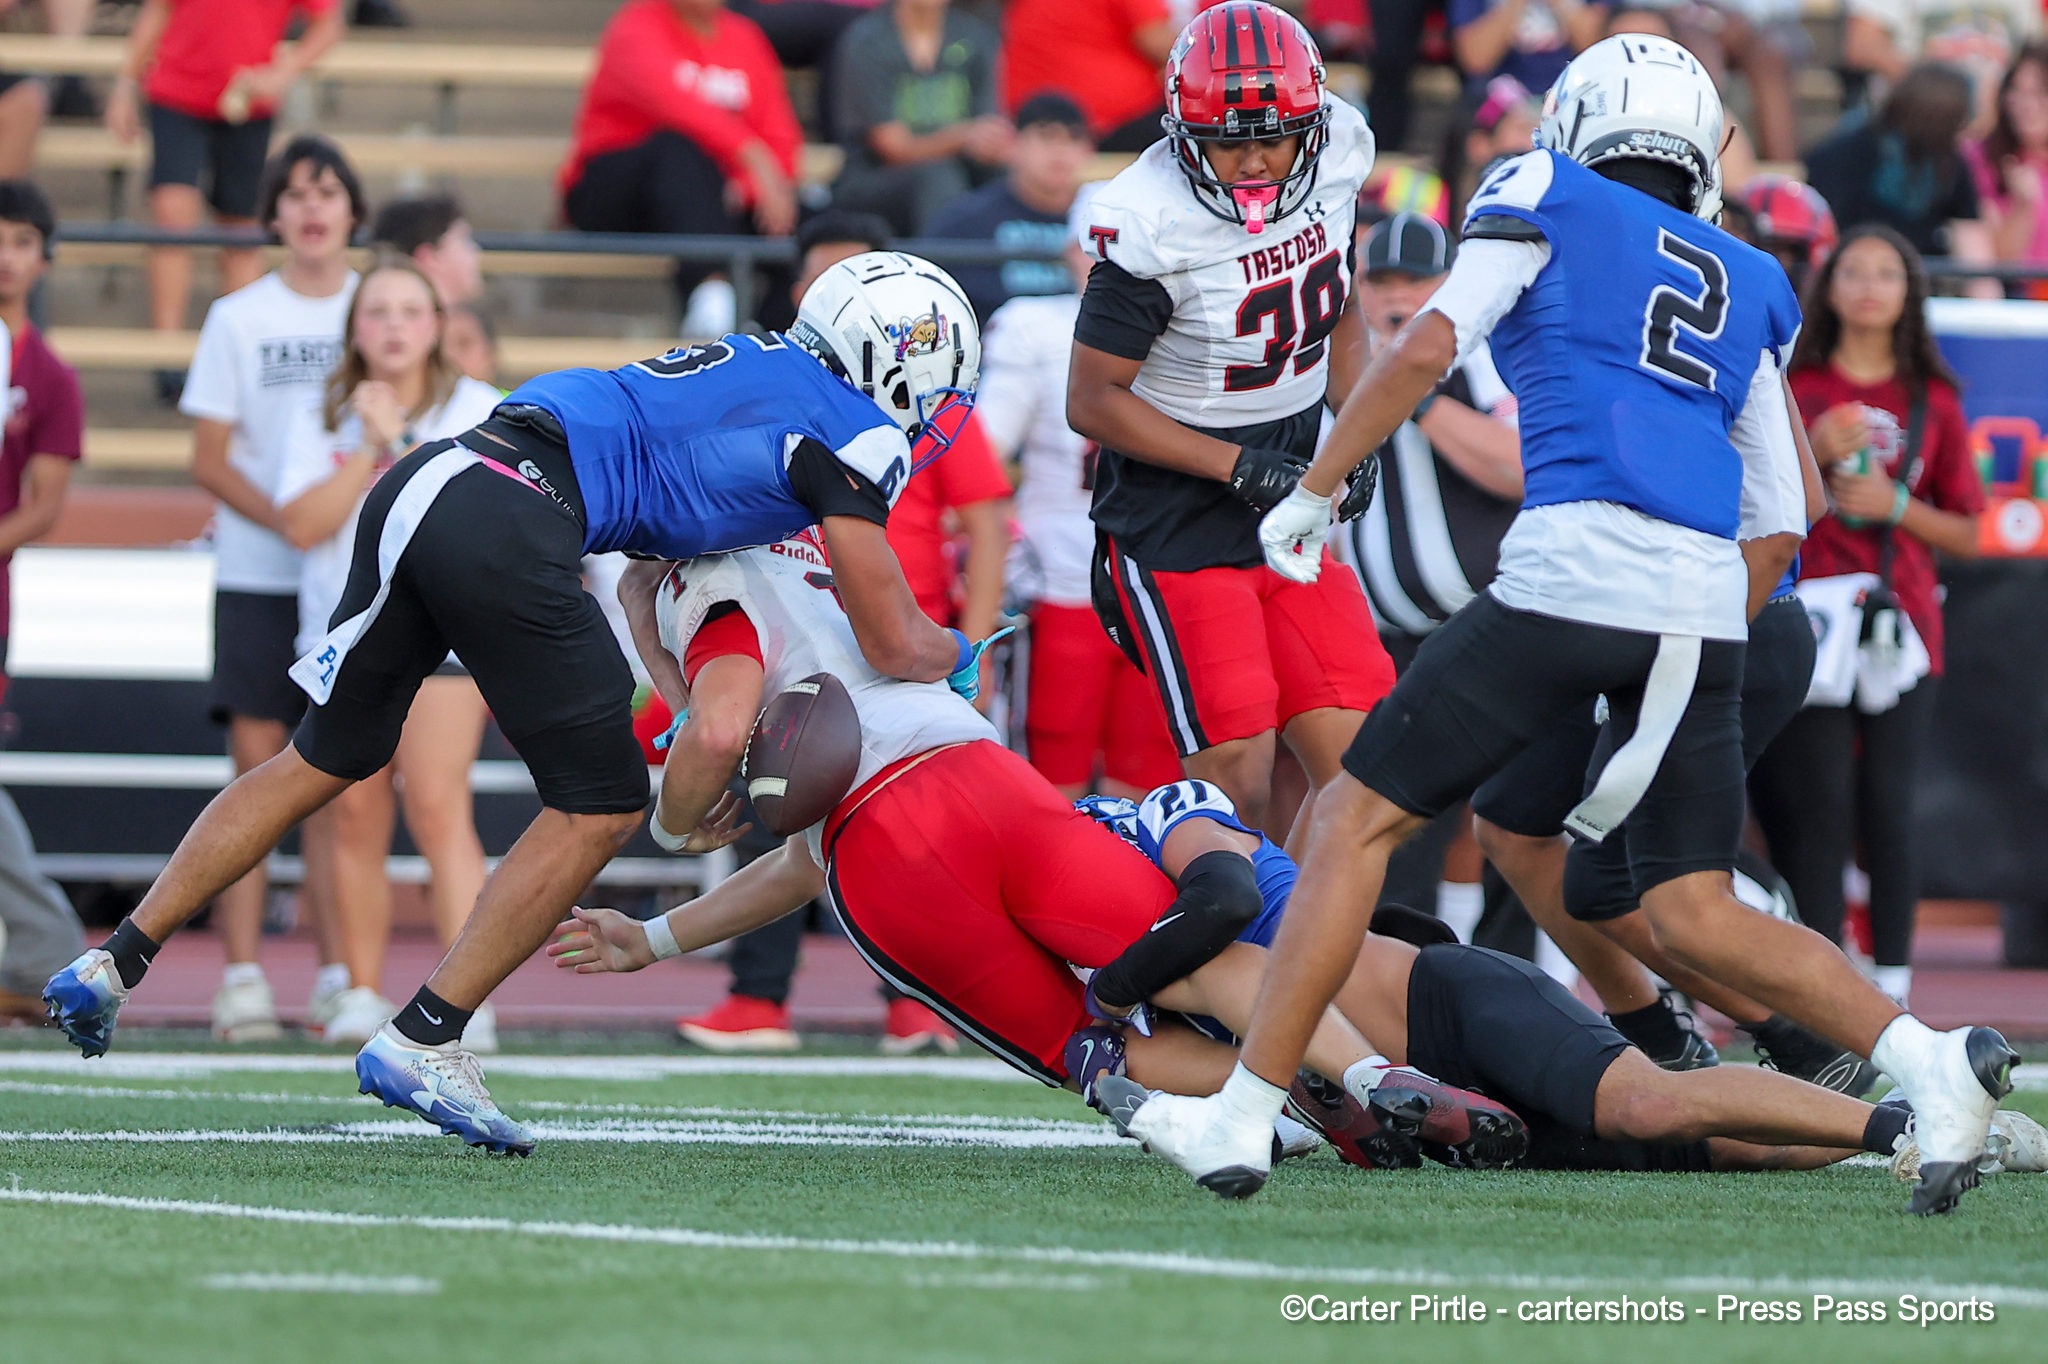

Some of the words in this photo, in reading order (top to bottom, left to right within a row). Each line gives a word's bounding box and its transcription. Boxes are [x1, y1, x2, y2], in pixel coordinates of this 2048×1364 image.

[1628, 130, 1690, 153] schutt
[1089, 225, 1119, 259] T
[1237, 221, 1328, 285] TASCOSA
[1639, 225, 1731, 392] 2
[791, 319, 820, 348] chutt
[876, 455, 906, 502] 6
